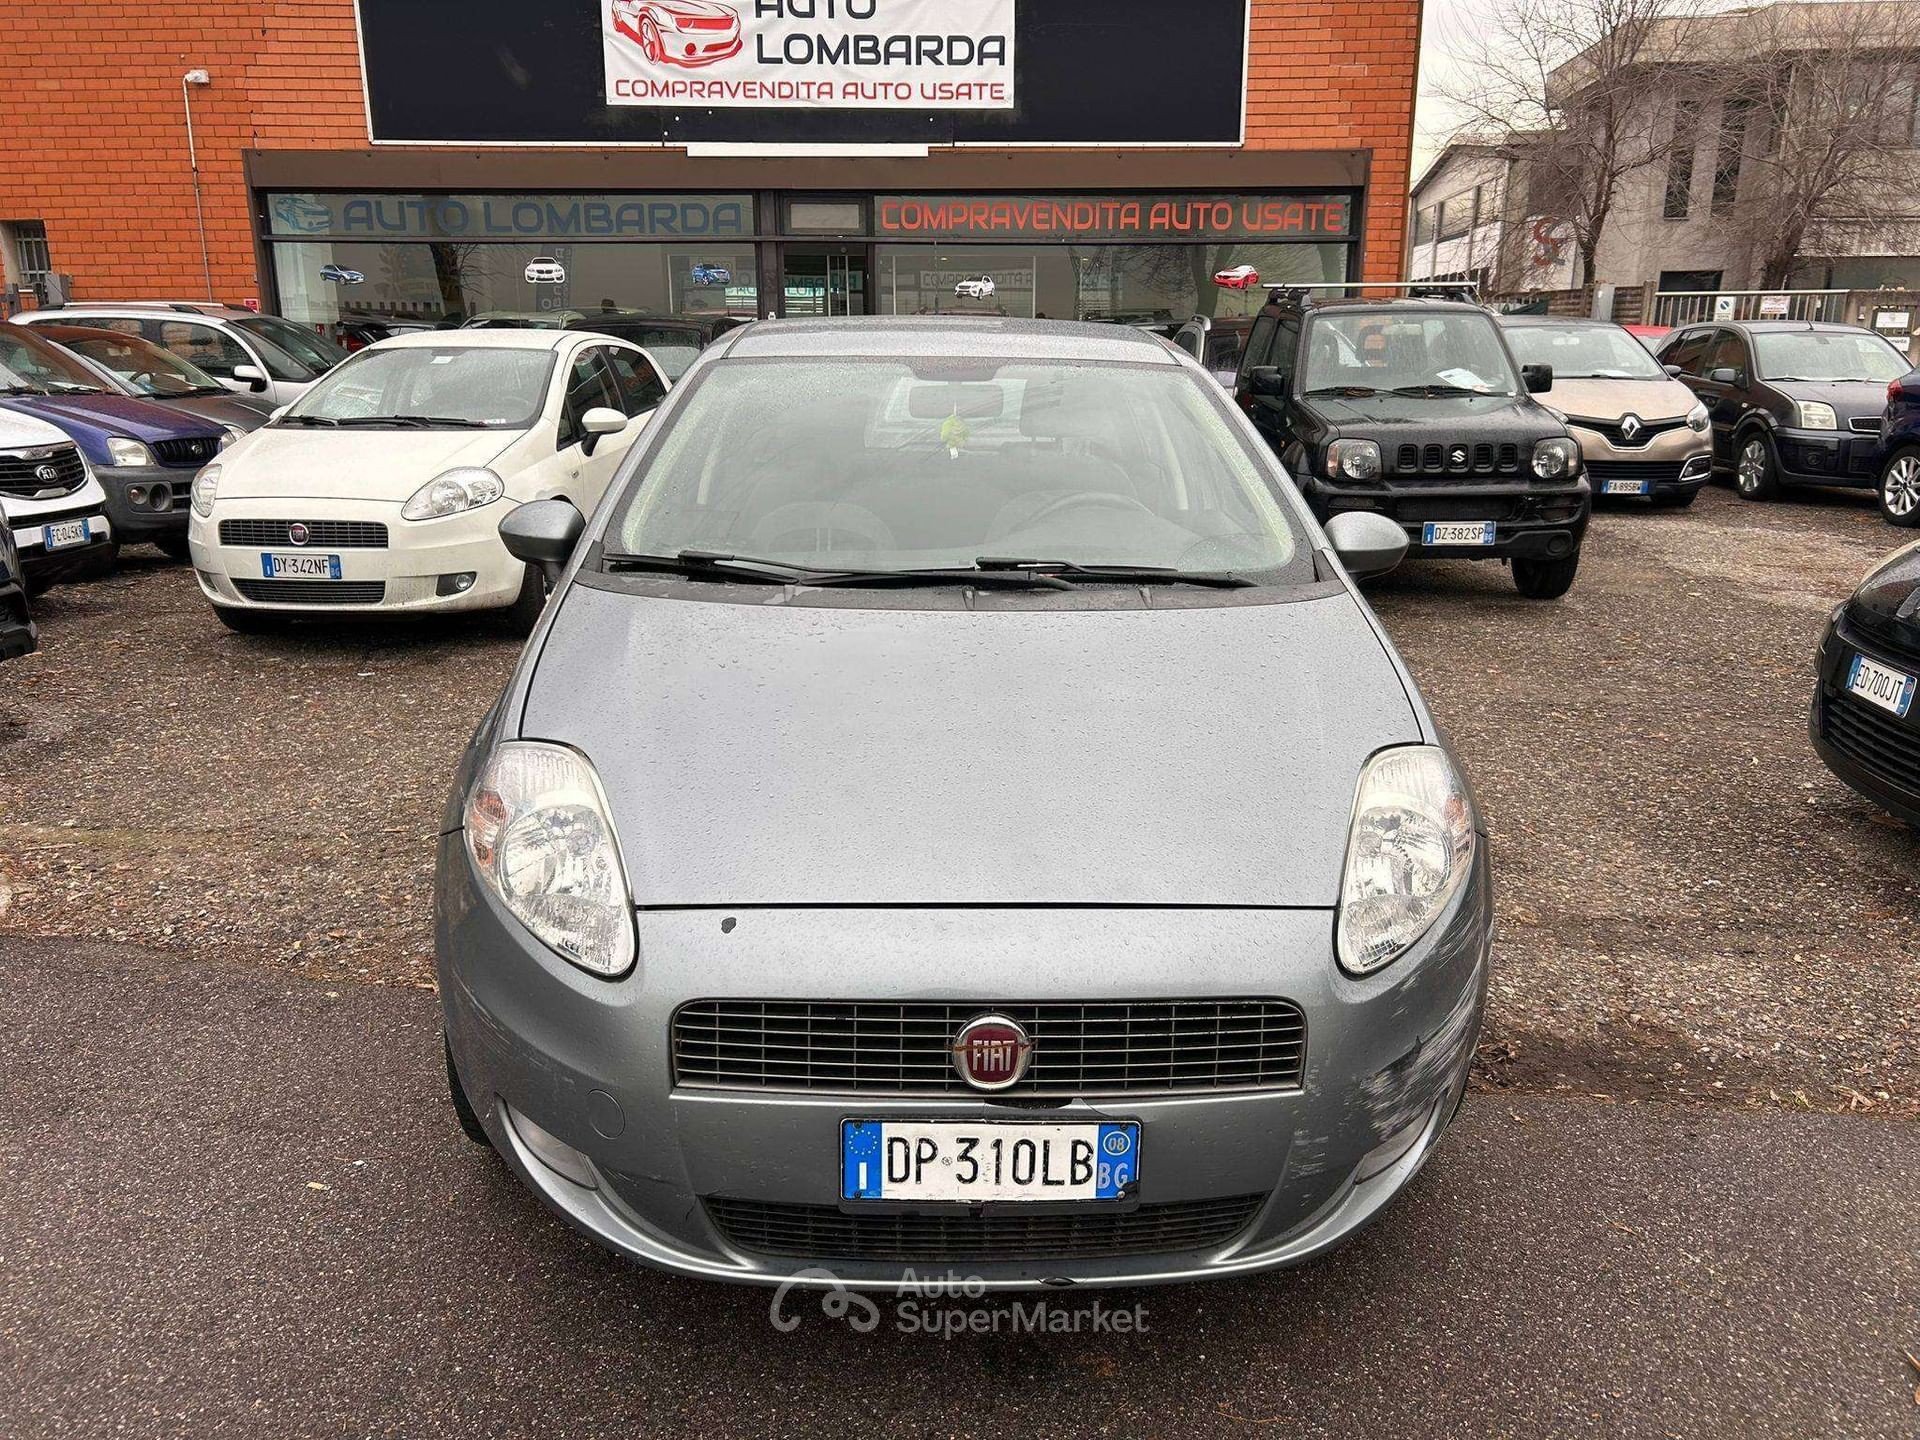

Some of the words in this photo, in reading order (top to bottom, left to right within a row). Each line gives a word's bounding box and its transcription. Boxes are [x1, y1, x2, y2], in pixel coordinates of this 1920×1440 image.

[755, 0, 877, 19] AUTO
[756, 34, 1006, 66] LOMBARDA
[615, 79, 833, 99] COMPRAVENDITA
[842, 82, 912, 100] AUTO
[920, 82, 1005, 101] USATE
[343, 199, 470, 234] AUTO
[484, 201, 743, 235] LOMBARDA
[880, 202, 1140, 231] COMPRAVENDITA
[1149, 202, 1233, 231] AUTO
[1240, 202, 1344, 232] USATE
[971, 1039, 1016, 1072] FIAT
[1106, 1137, 1126, 1151] 08
[1097, 1162, 1130, 1189] BG
